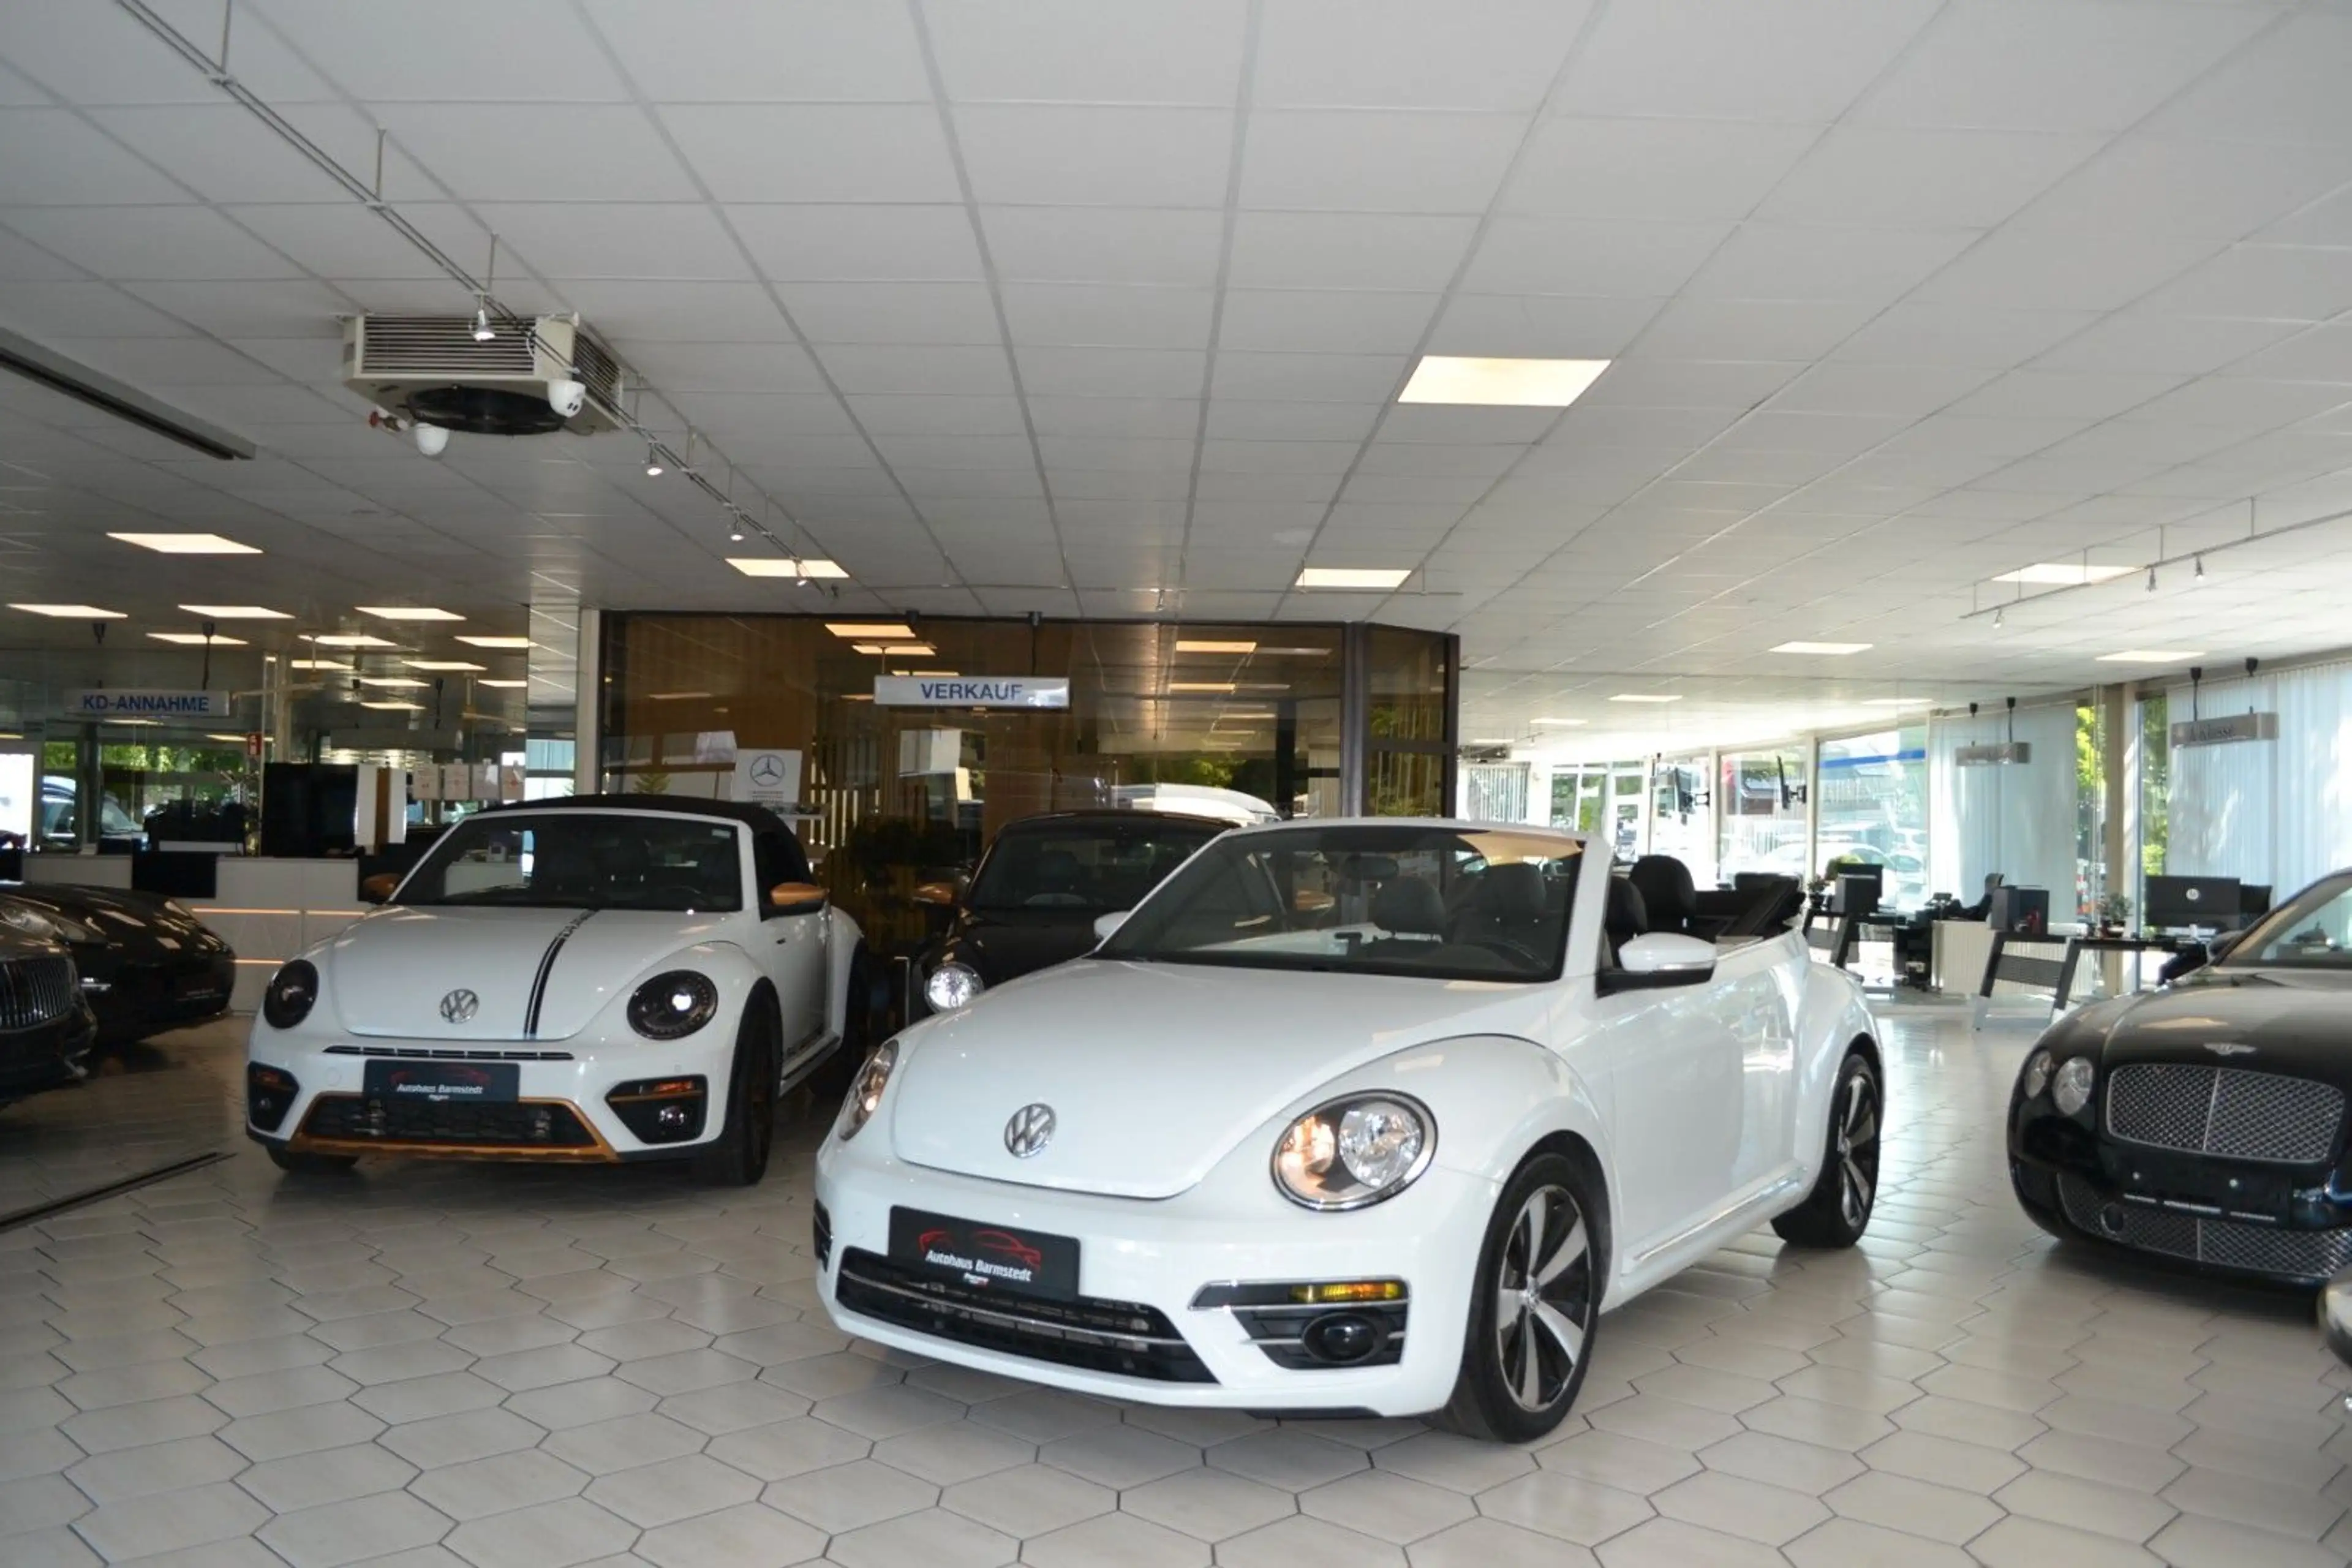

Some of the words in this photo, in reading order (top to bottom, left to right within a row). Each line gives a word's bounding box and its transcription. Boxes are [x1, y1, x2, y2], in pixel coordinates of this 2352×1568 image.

[921, 683, 1023, 700] VERKAUF
[83, 695, 209, 711] KD-ANNAHME
[925, 1250, 973, 1270] Autohaus
